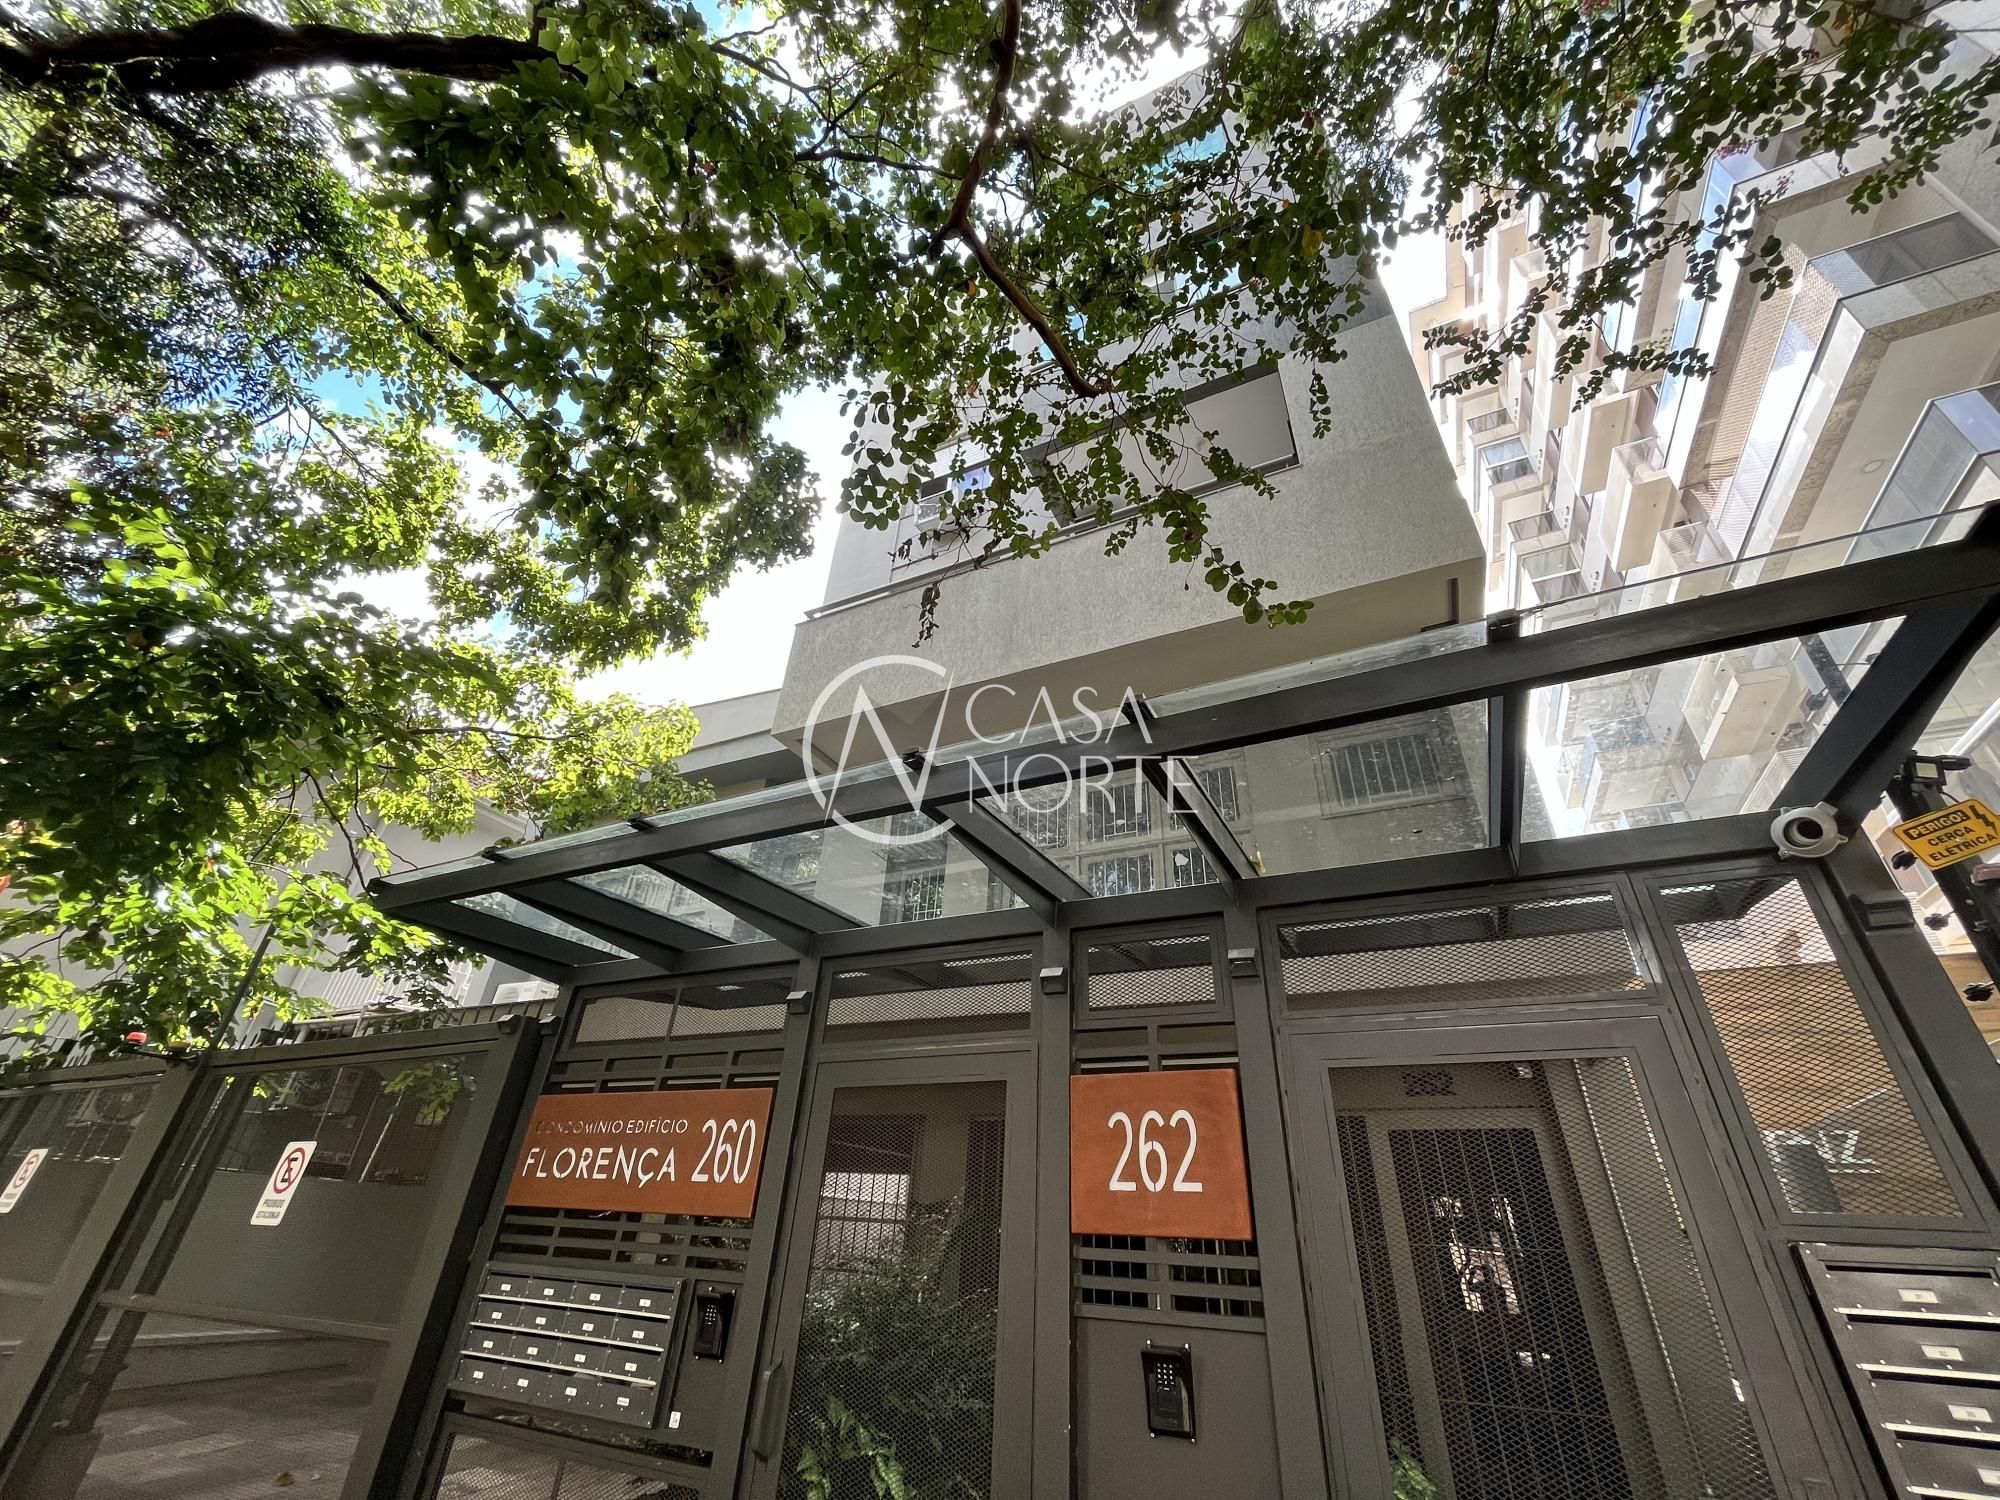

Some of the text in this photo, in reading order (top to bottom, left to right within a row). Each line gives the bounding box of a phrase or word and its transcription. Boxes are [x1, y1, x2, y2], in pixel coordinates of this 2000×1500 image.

[1907, 811, 1968, 838] PERIGO!
[1927, 826, 1976, 847] CERCA
[1928, 833, 1999, 862] ELÉTRICA
[625, 1116, 689, 1134] EDIFÍCIO
[521, 1118, 756, 1188] FLORENÇA 260
[1107, 1109, 1203, 1193] 262
